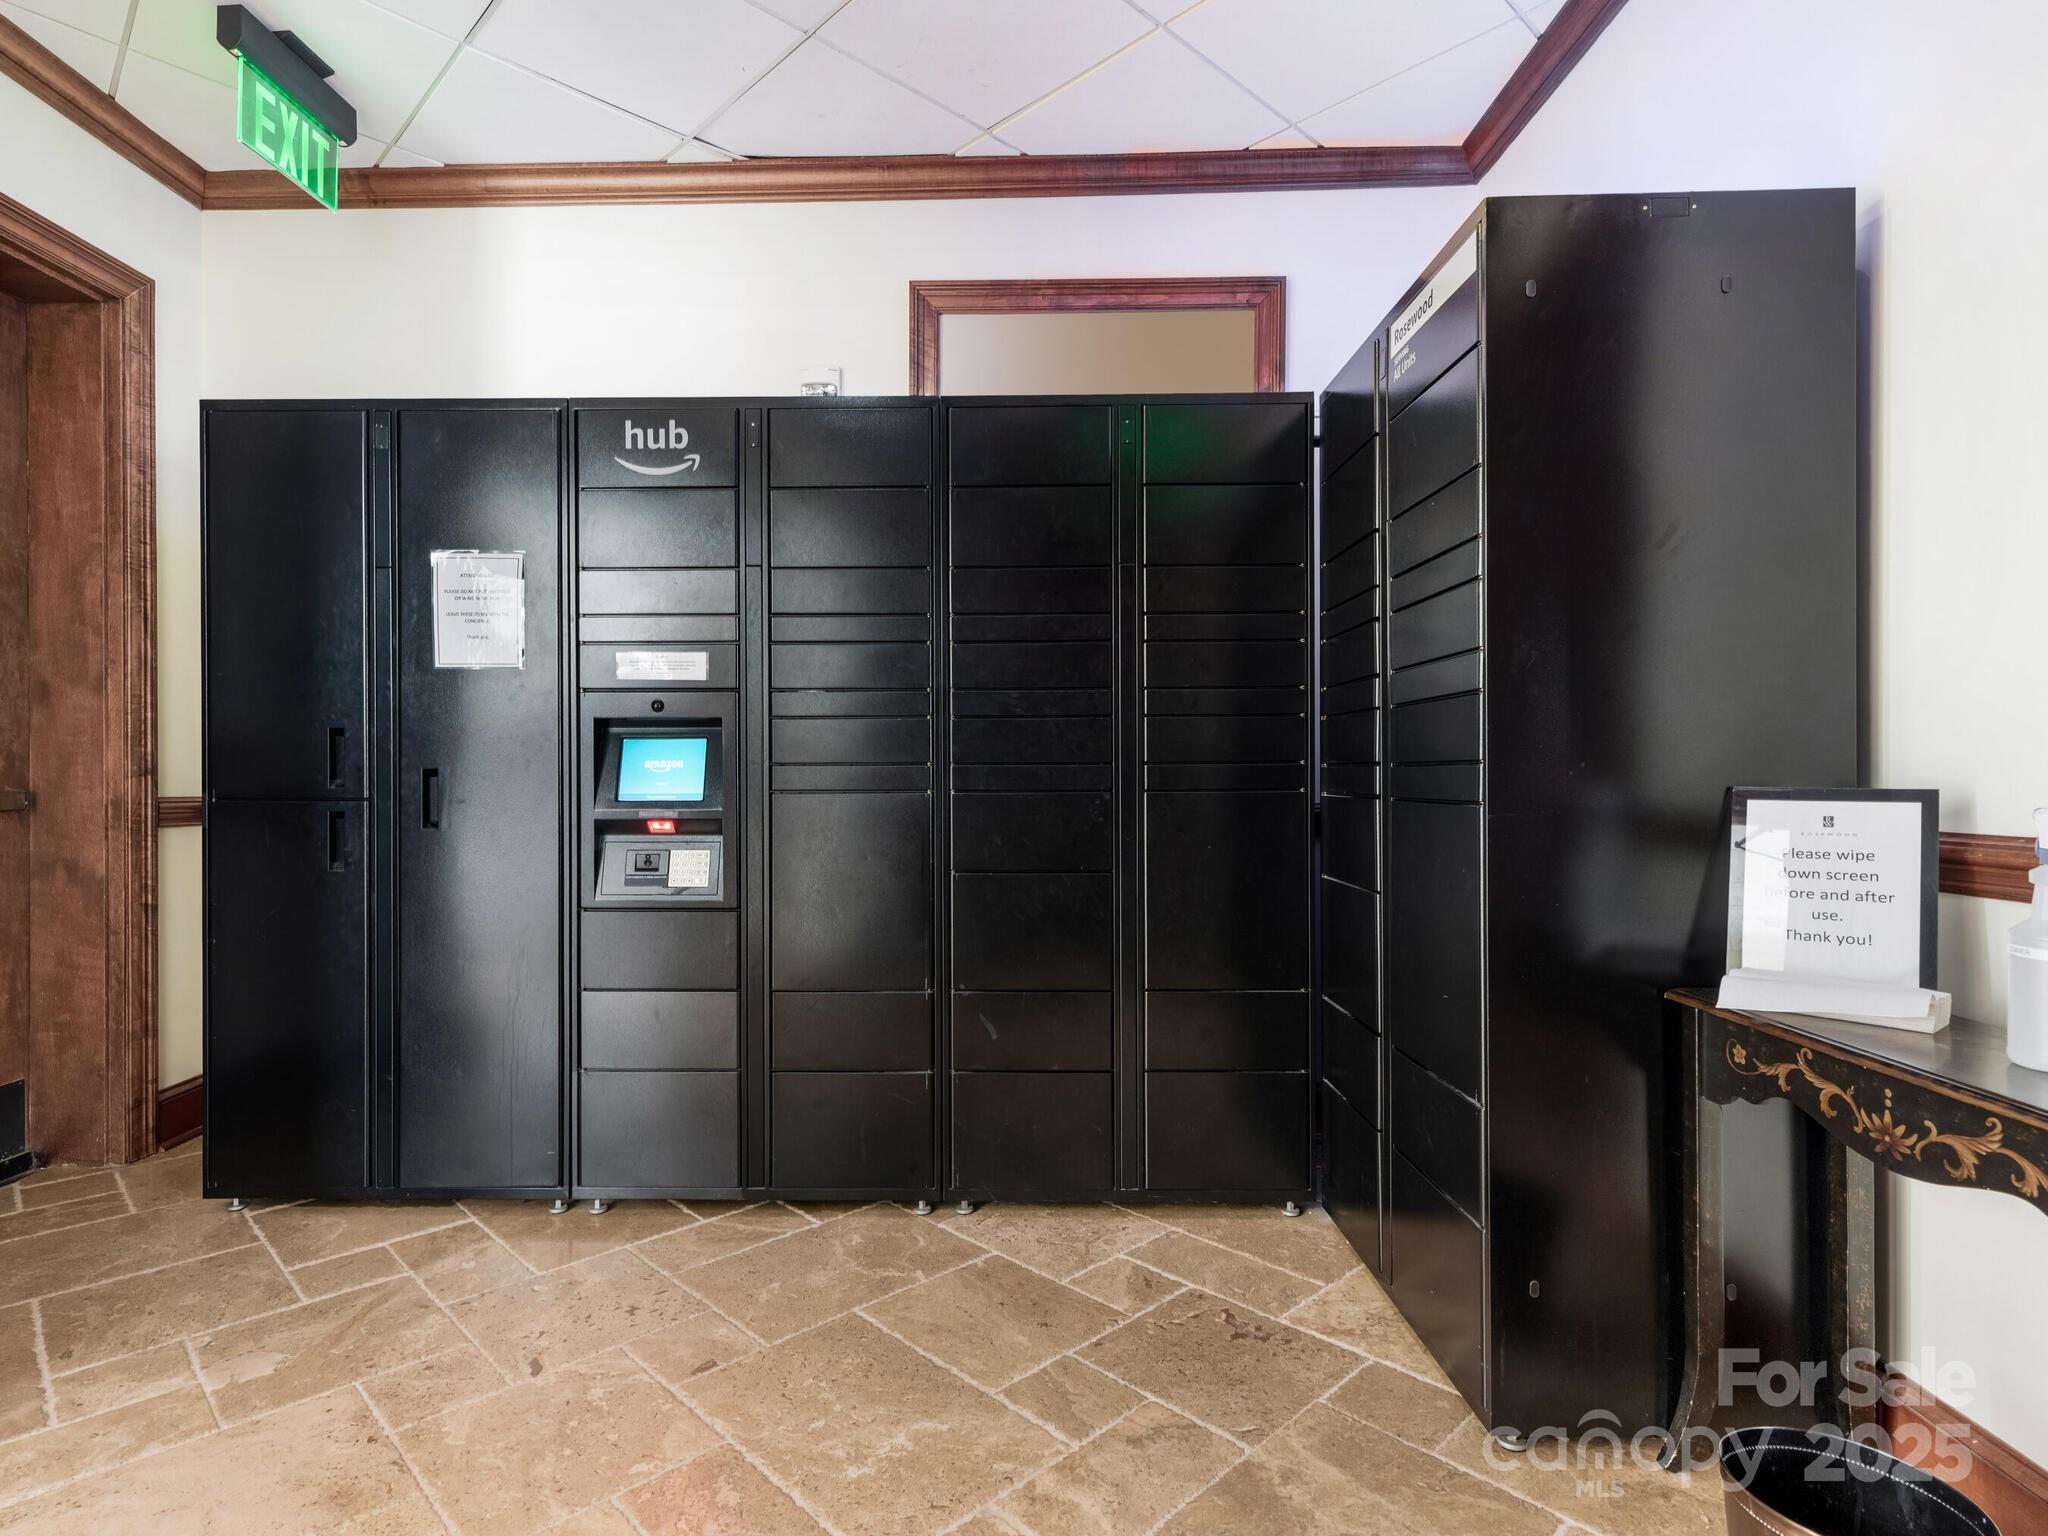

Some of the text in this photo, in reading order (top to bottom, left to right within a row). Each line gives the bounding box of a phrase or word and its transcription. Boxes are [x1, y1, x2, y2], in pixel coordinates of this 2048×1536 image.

[255, 81, 330, 199] EXIT
[1394, 288, 1434, 346] Rosewood
[1402, 352, 1416, 374] Units
[625, 419, 689, 450] hub
[644, 759, 684, 770] amazon
[1836, 849, 1875, 863] wipe
[1826, 871, 1879, 882] screen
[1820, 889, 1850, 901] and
[1855, 890, 1895, 904] after
[1786, 929, 1872, 946] Thank you!
